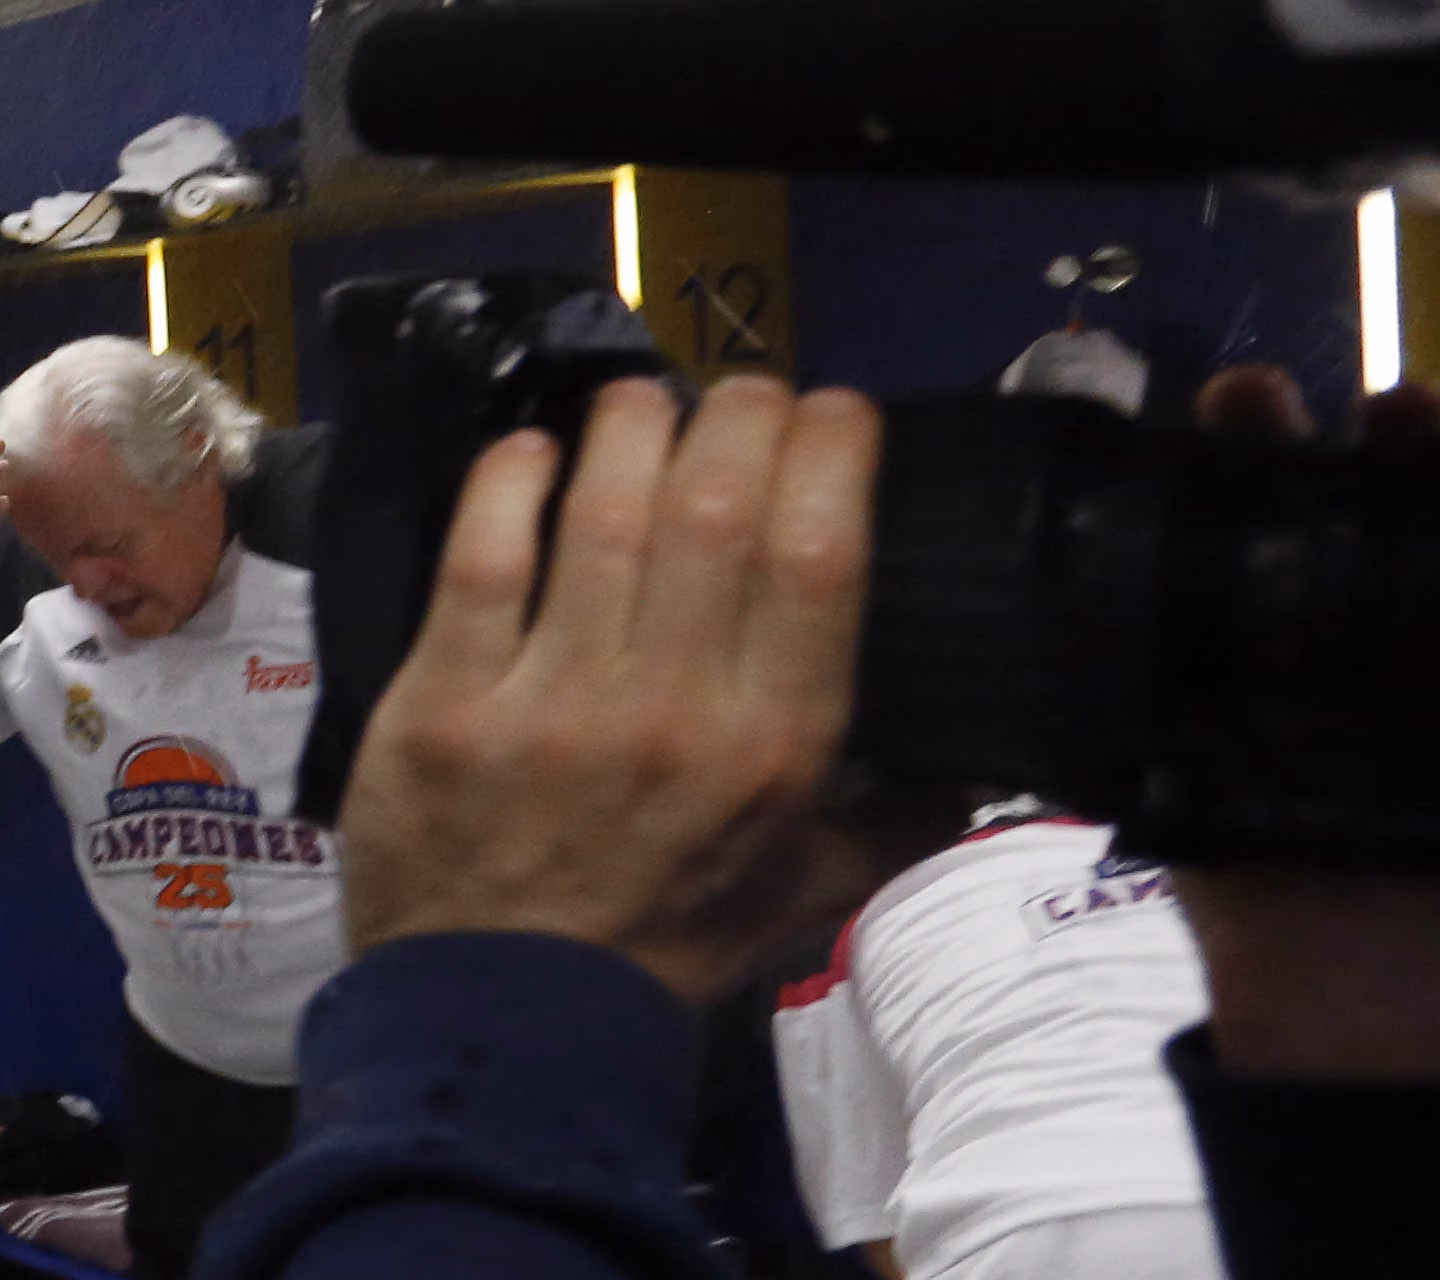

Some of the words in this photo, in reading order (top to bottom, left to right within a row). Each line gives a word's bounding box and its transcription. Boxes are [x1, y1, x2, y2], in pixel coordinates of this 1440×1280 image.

[673, 262, 771, 363] 12
[195, 322, 259, 404] 11
[153, 863, 233, 910] 25
